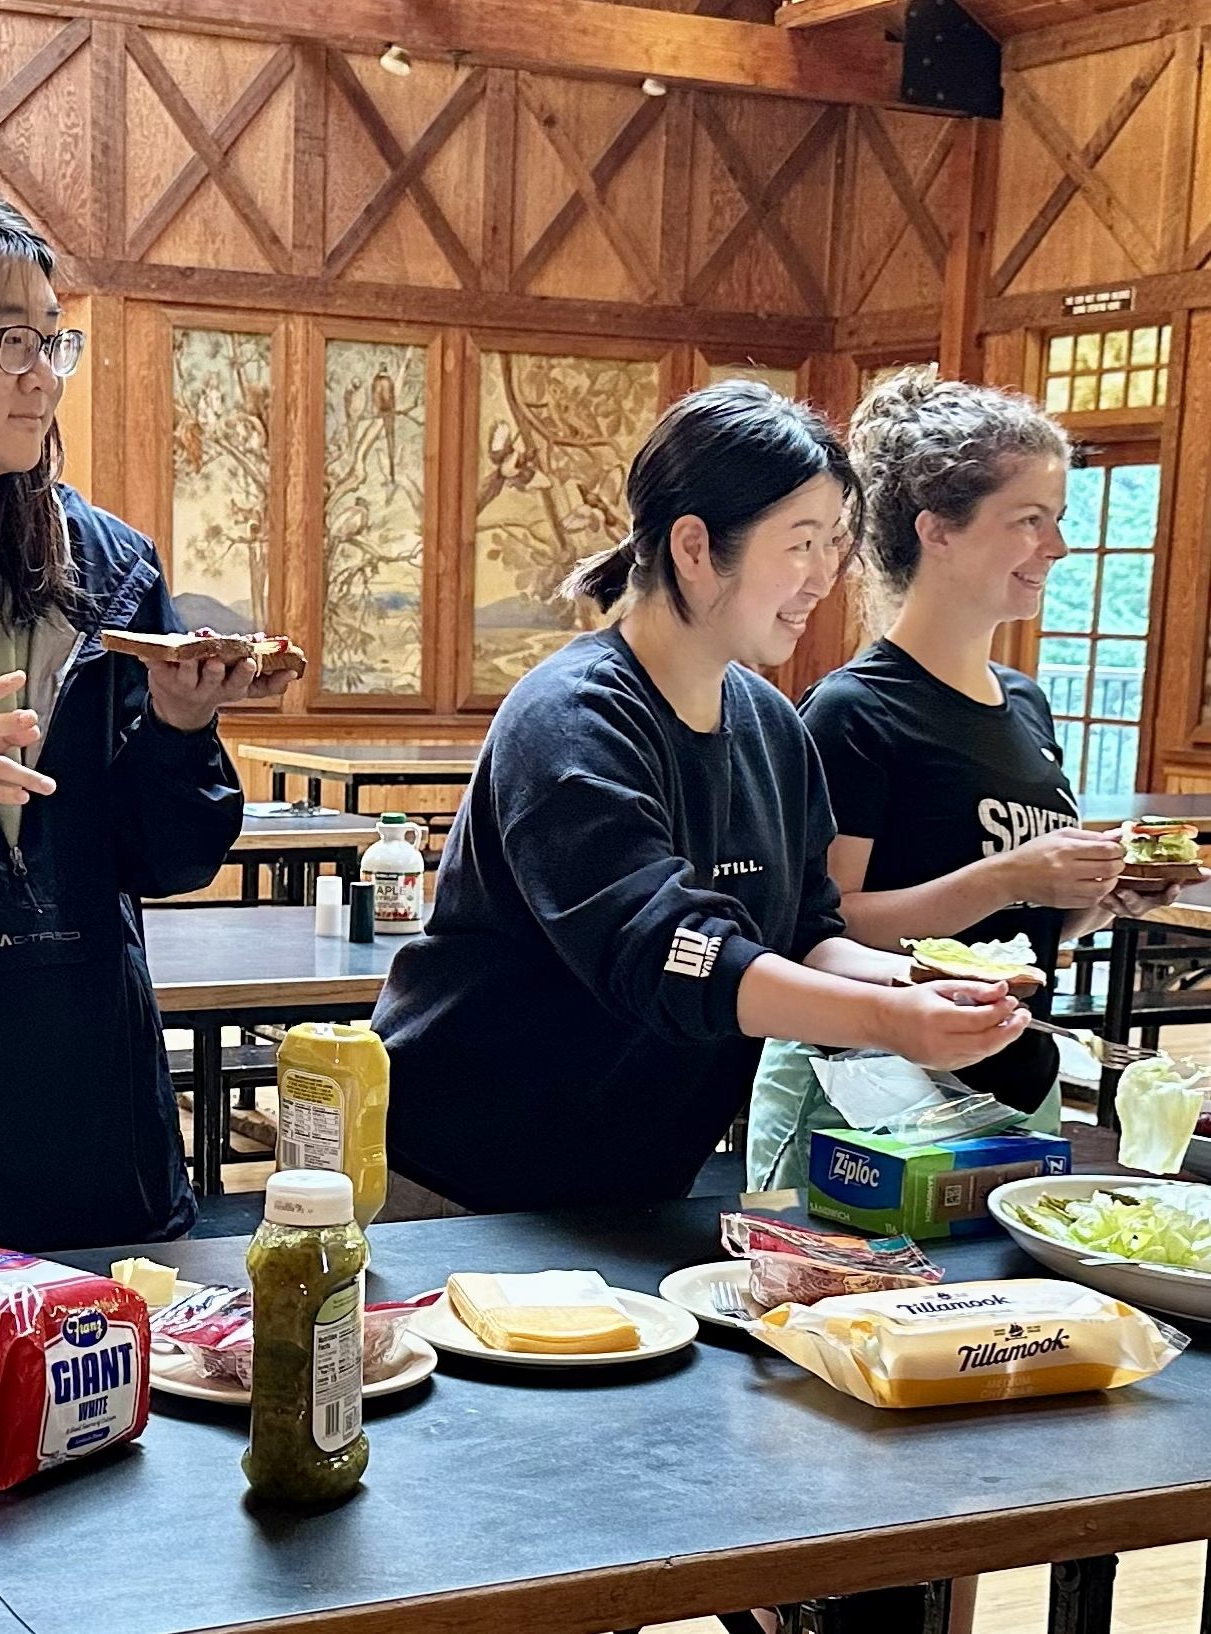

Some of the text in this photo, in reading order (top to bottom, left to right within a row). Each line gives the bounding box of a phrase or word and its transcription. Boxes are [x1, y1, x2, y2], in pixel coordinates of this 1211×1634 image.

[376, 885, 407, 896] APLE
[833, 1151, 880, 1188] Ziploc
[896, 1295, 1012, 1315] Tillamook
[958, 1328, 1070, 1372] Tillamook
[51, 1343, 133, 1405] GIANT
[78, 1395, 109, 1422] WHITE
